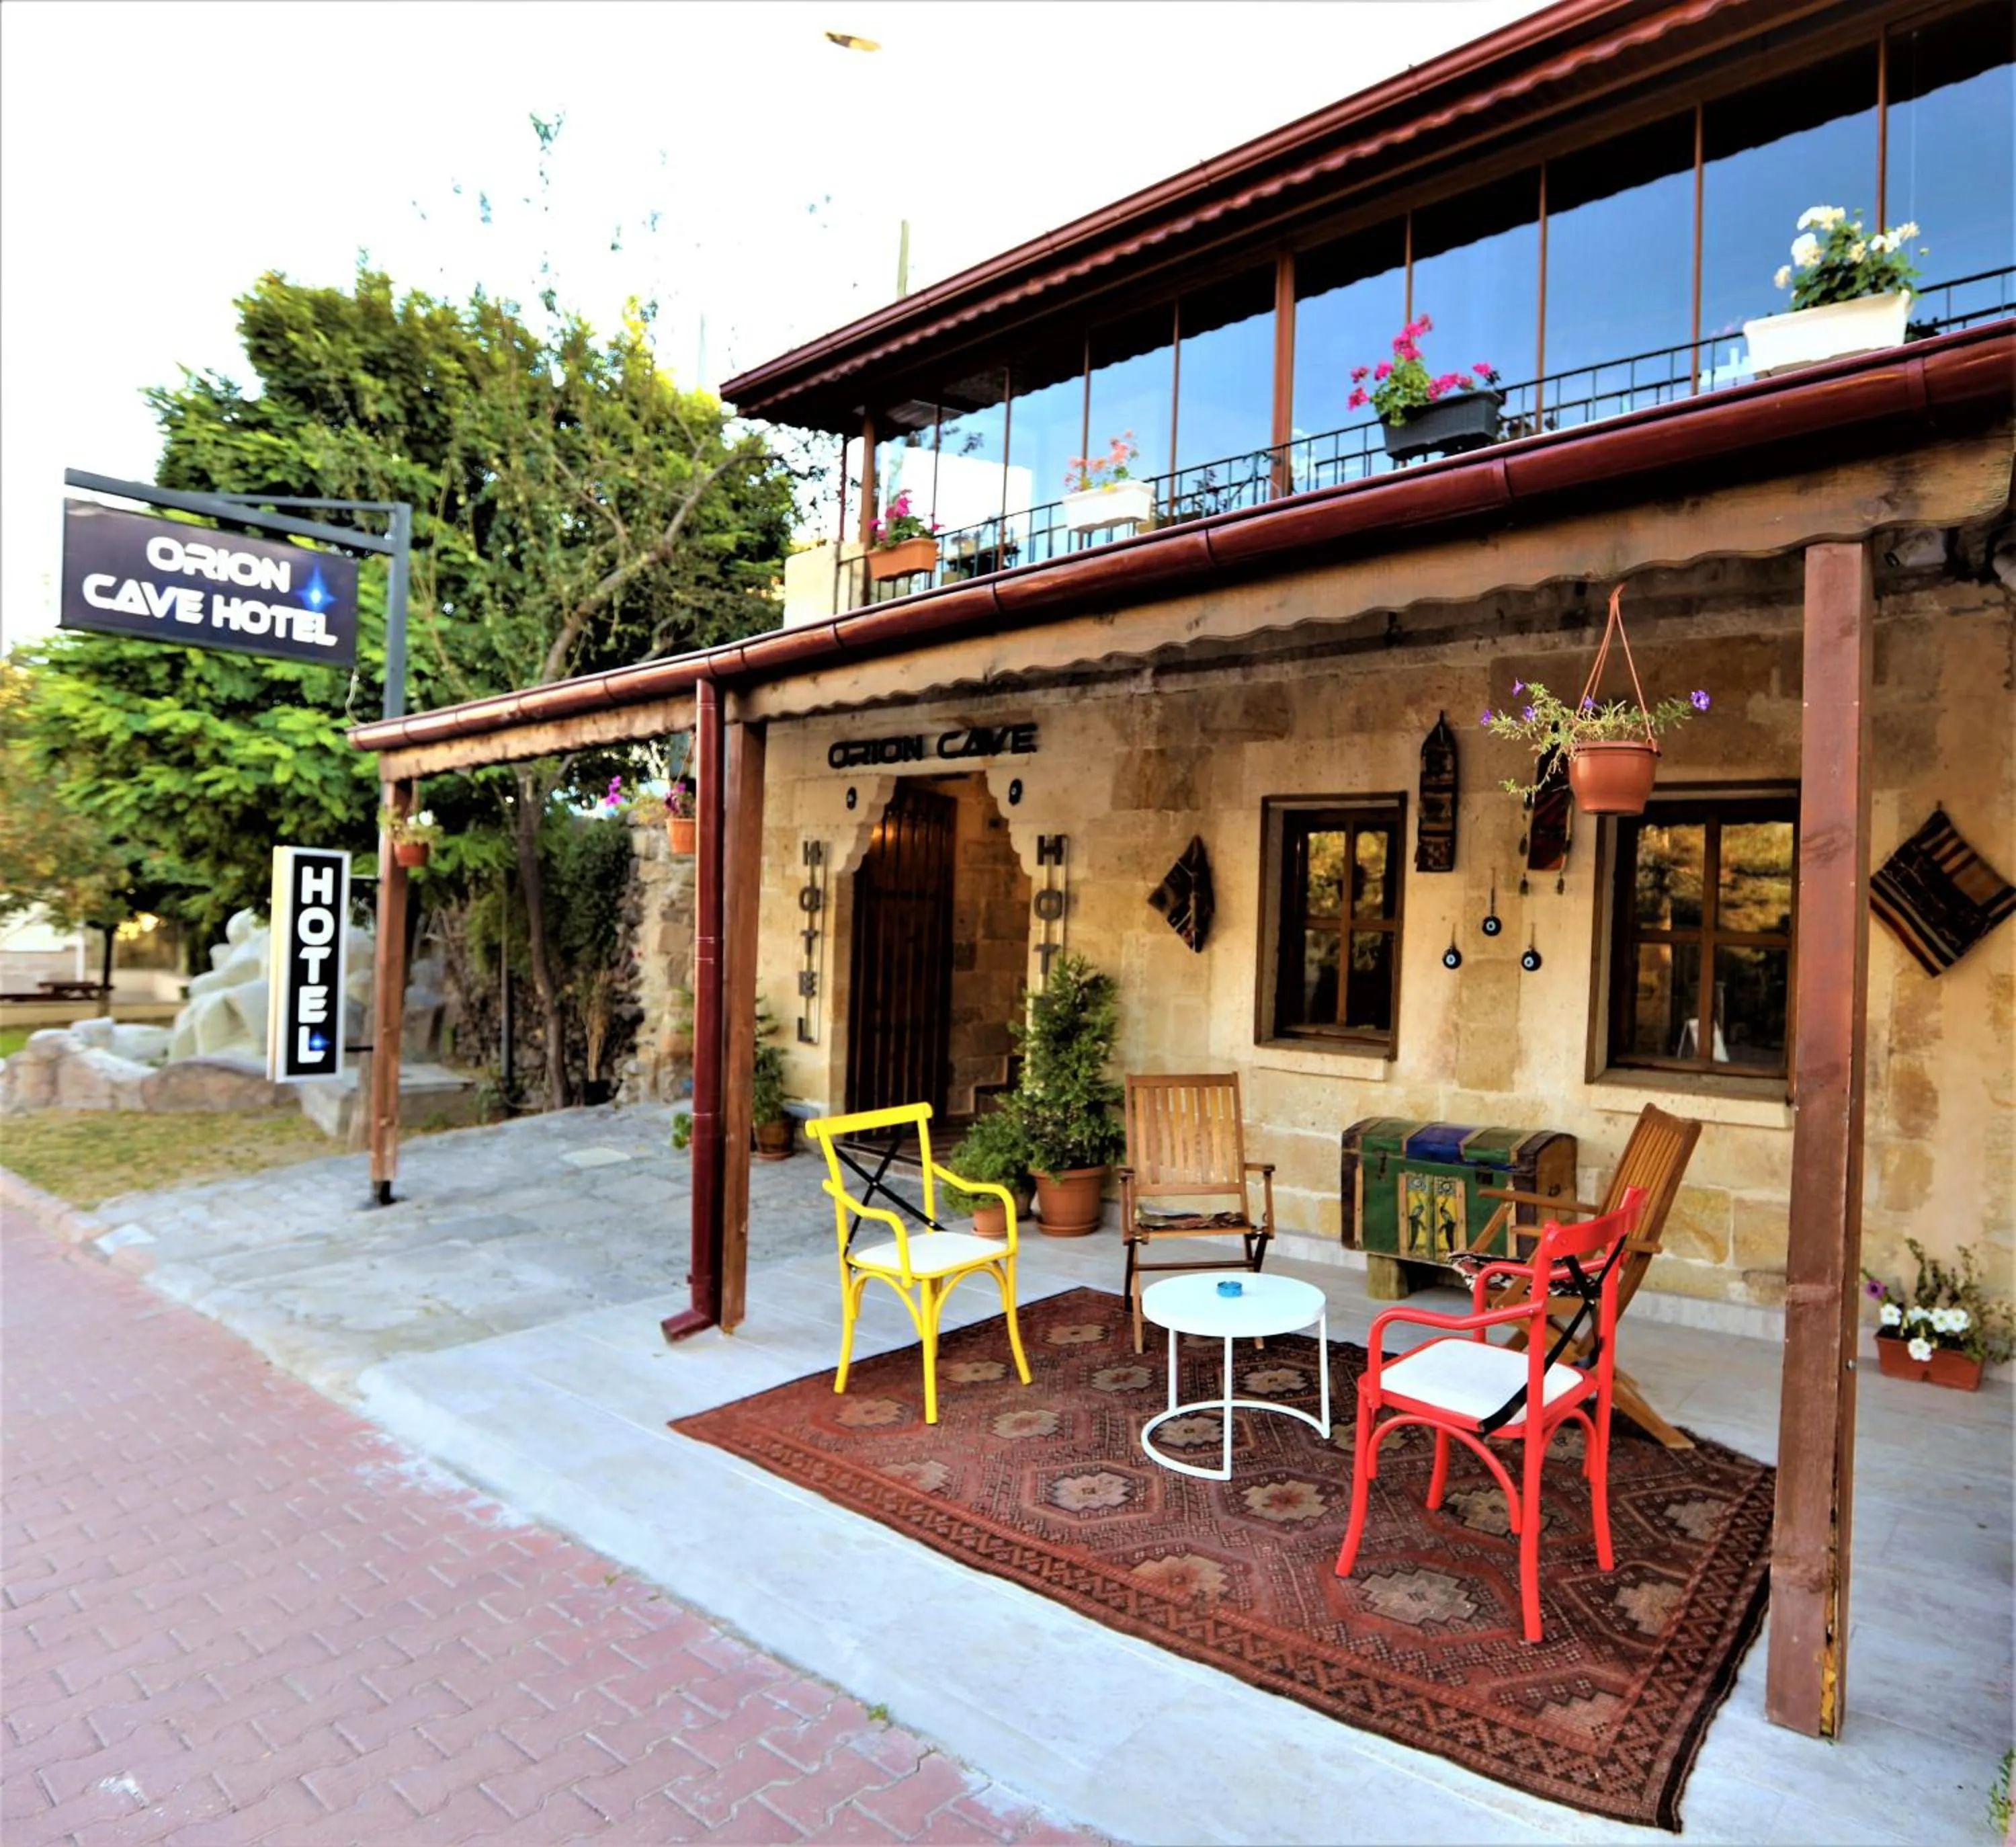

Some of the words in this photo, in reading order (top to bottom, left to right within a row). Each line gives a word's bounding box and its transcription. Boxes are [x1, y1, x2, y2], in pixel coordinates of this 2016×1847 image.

[82, 573, 206, 624] CAVE
[212, 593, 338, 647] HOTEL
[146, 536, 291, 593] ORION
[828, 734, 923, 769] ORION
[936, 722, 1039, 760] CAVE
[297, 866, 335, 1064] HOTEL
[797, 839, 824, 1042] HOTEL
[1034, 834, 1064, 1009] HOT
